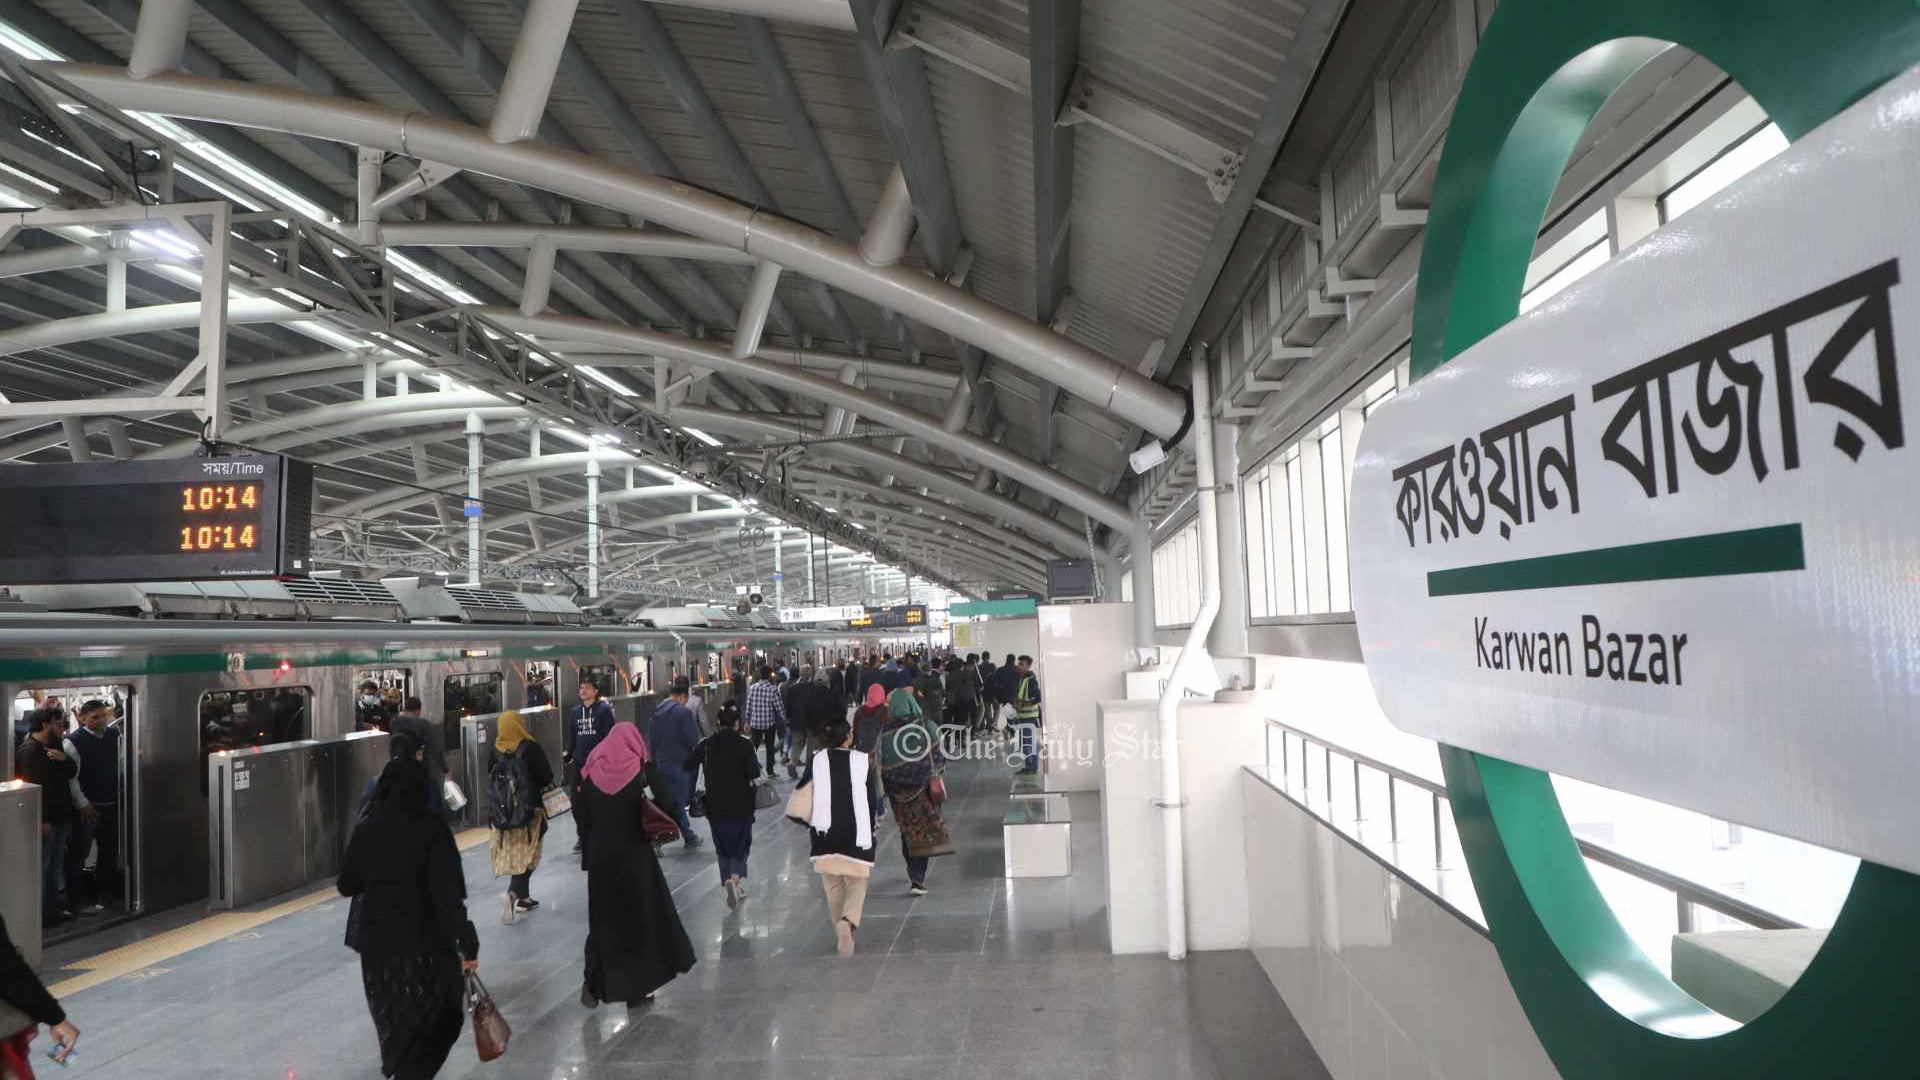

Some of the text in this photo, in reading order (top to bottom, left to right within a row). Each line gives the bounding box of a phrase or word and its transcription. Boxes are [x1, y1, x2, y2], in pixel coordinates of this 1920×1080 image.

[1392, 257, 1905, 548] কারওয়ান বাজার
[183, 486, 257, 510] 10:14
[180, 525, 254, 549] 10:14
[1475, 614, 1688, 686] Karwan Bazar
